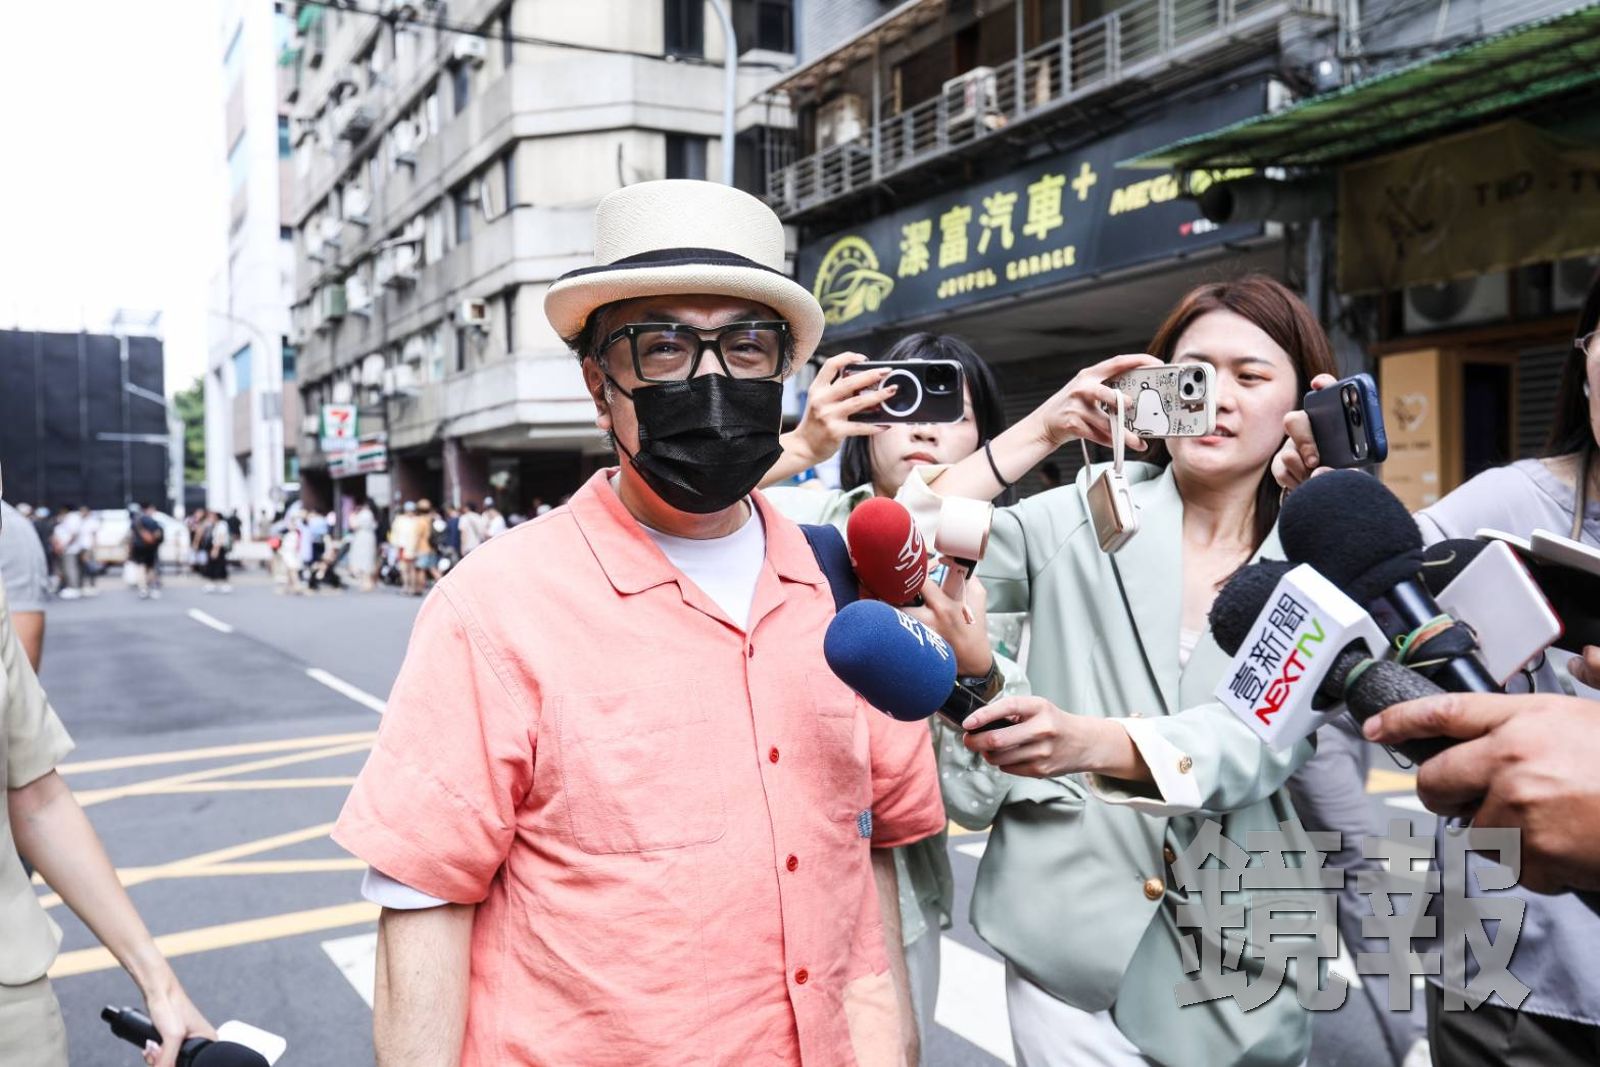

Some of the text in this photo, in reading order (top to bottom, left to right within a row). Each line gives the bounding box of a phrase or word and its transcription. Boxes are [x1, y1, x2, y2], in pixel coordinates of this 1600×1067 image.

[937, 245, 1075, 298] JOYFUL GARAGE
[1229, 592, 1309, 709] 壹新聞
